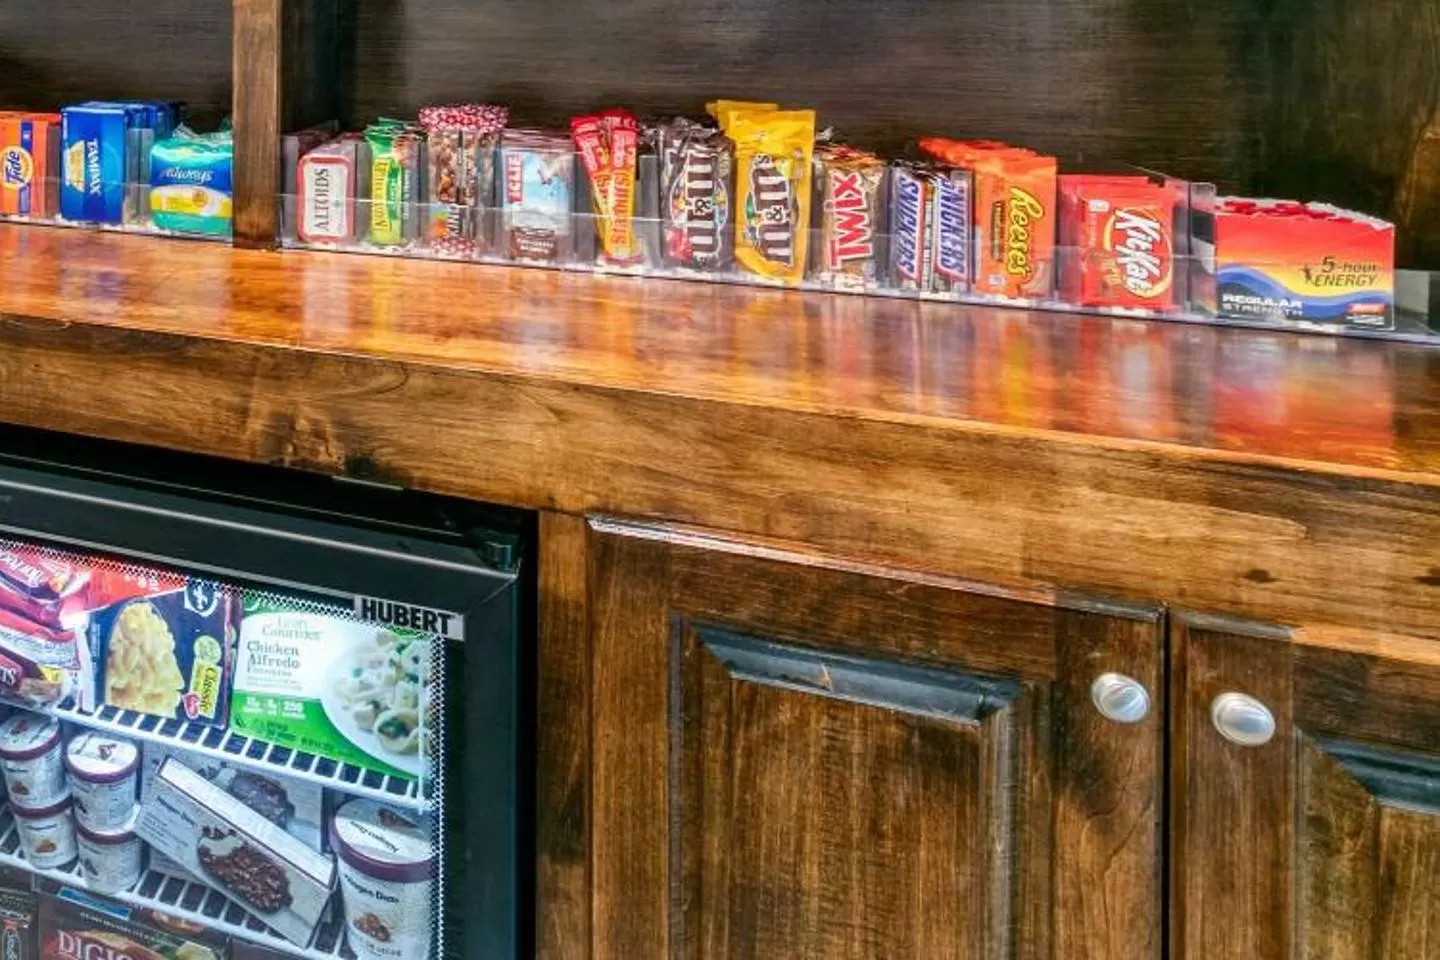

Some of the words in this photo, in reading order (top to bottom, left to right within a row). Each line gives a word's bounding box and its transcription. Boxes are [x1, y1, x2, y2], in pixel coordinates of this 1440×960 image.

[5, 149, 27, 185] Tide
[86, 138, 102, 196] TAMPAX
[314, 167, 330, 231] ALTOIDS
[830, 173, 872, 269] TWIX
[896, 175, 919, 274] SNICKERS
[938, 177, 965, 275] SNICKERS
[1008, 186, 1045, 277] Reese's
[1314, 273, 1377, 288] ENERGY
[361, 597, 453, 636] HUBERT
[247, 640, 300, 656] Chicken
[248, 652, 301, 669] Alfredo
